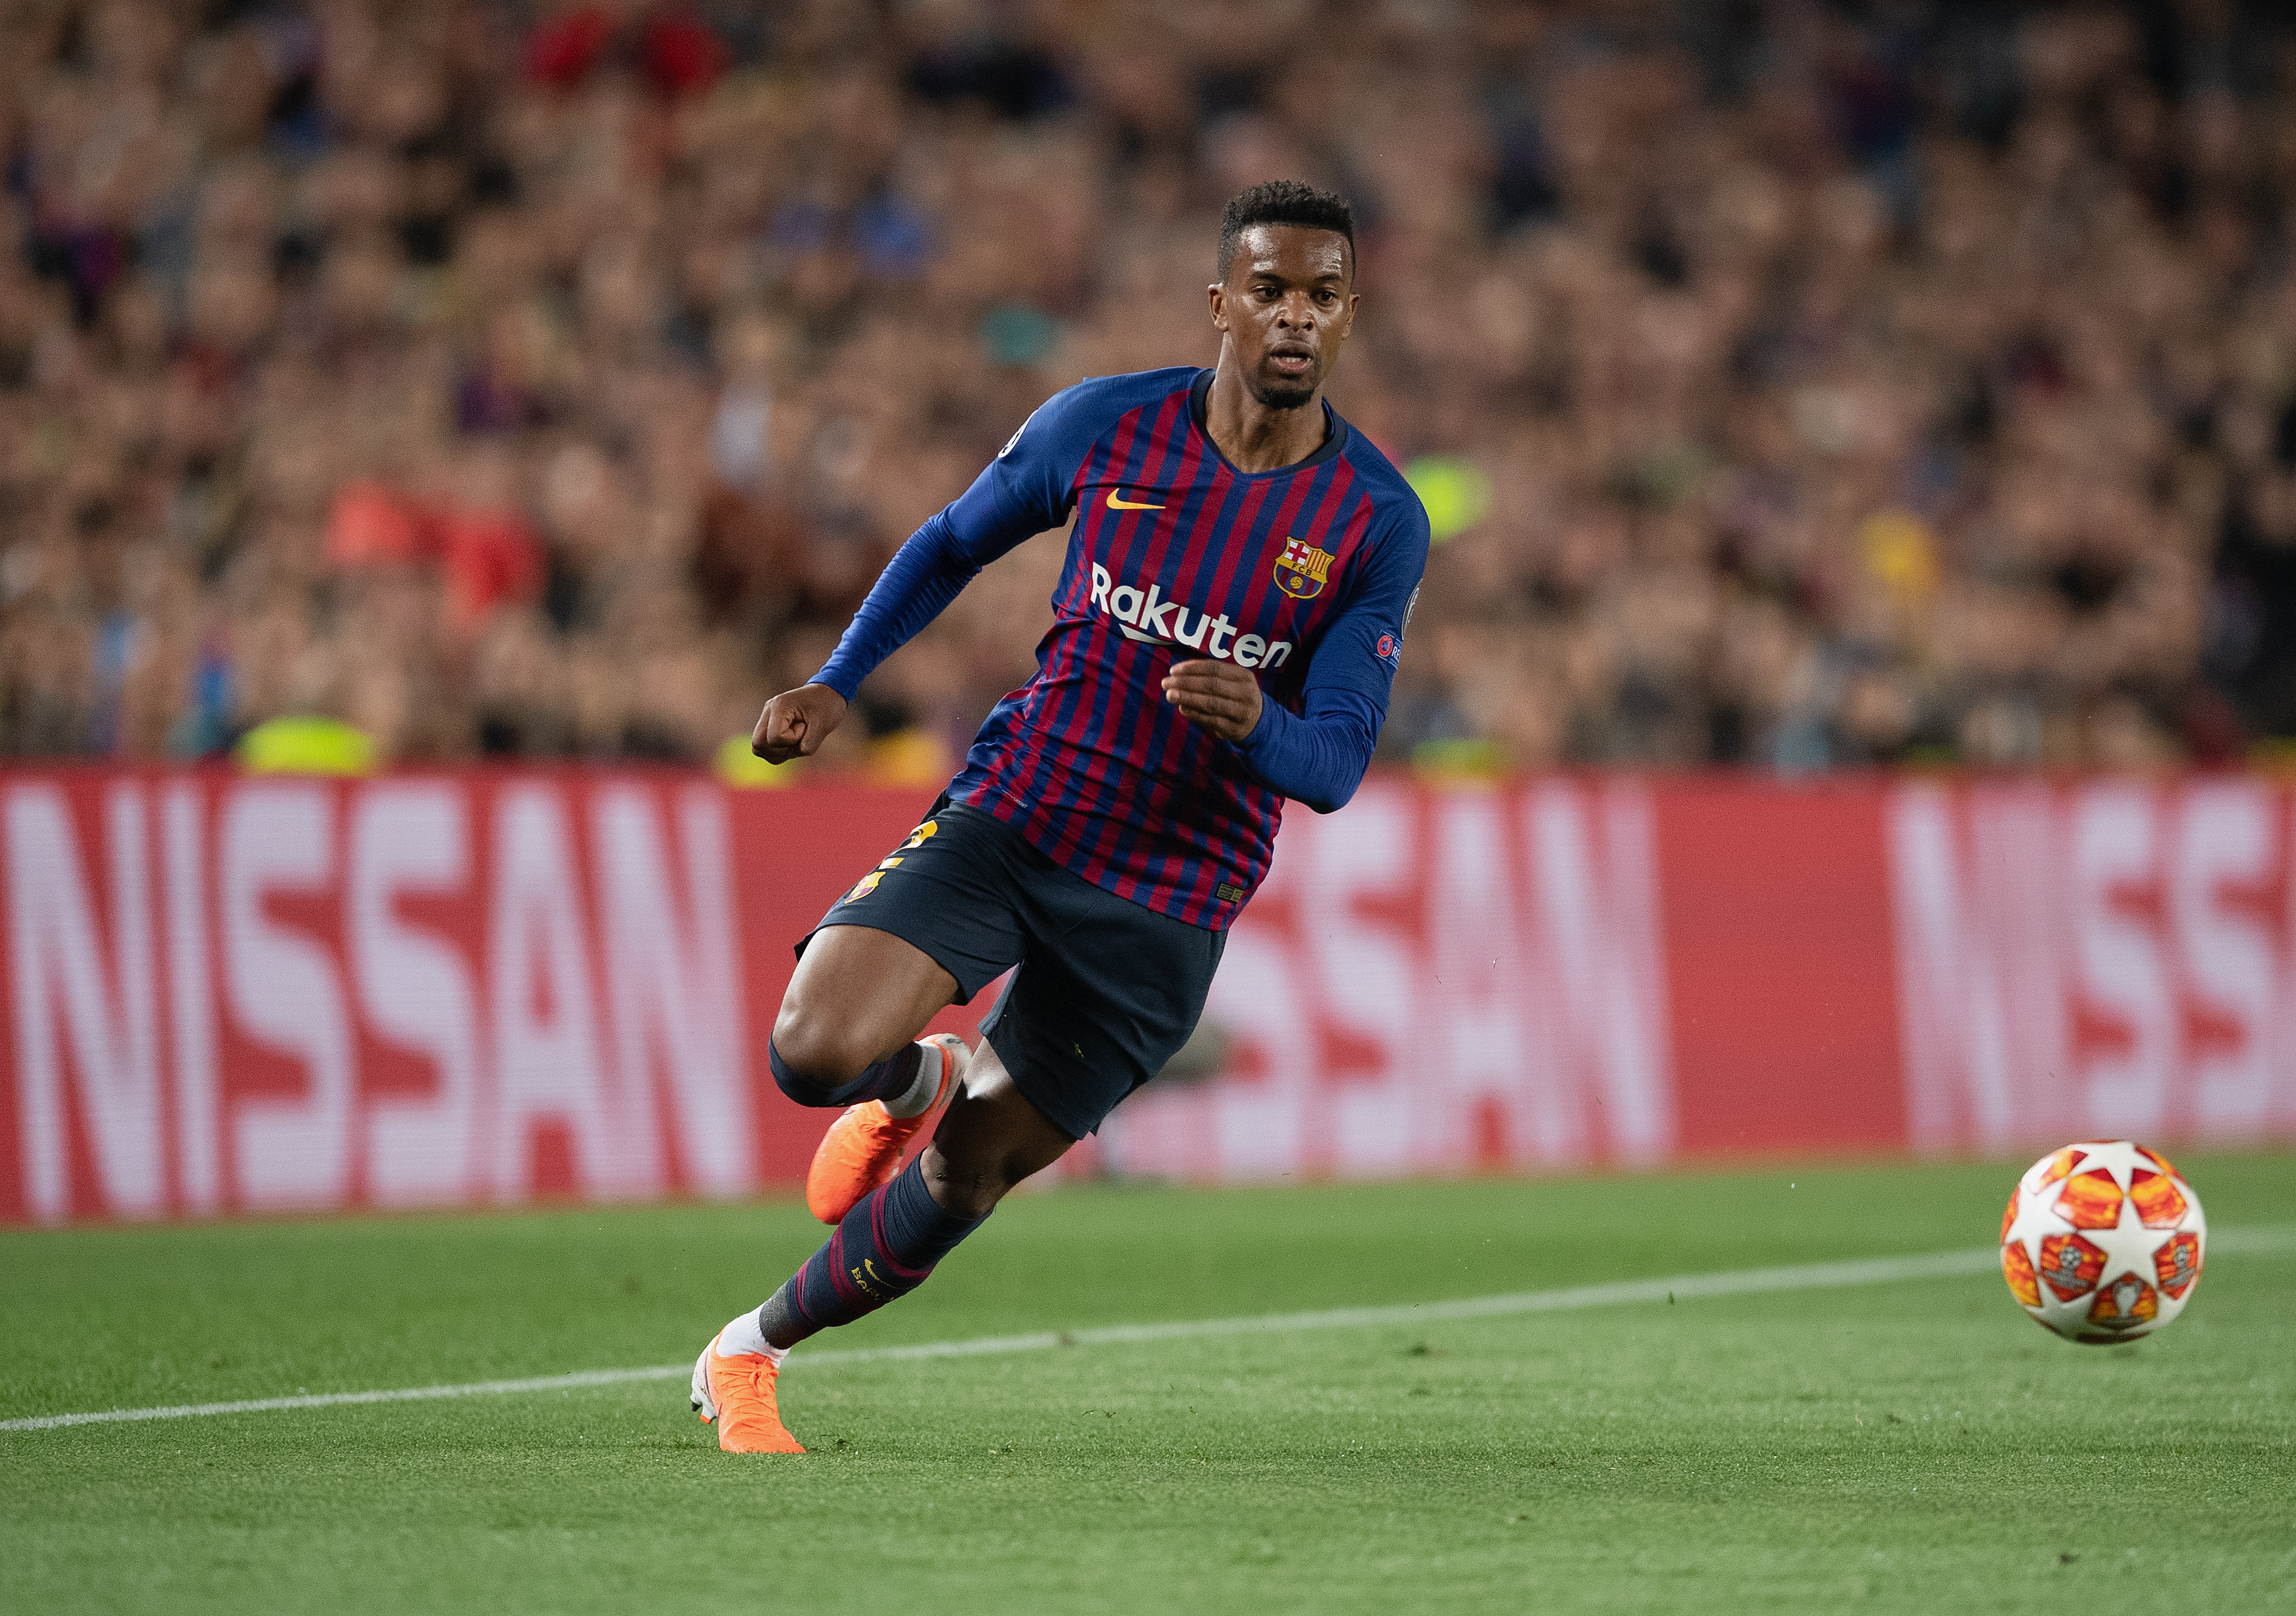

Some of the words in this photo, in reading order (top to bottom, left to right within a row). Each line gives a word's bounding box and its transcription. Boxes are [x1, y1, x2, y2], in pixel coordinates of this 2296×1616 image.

[1090, 562, 1293, 669] Rakuten
[1291, 563, 1312, 576] FCB
[5, 777, 756, 1221] NISSAN
[1104, 782, 1680, 1183] SSAN
